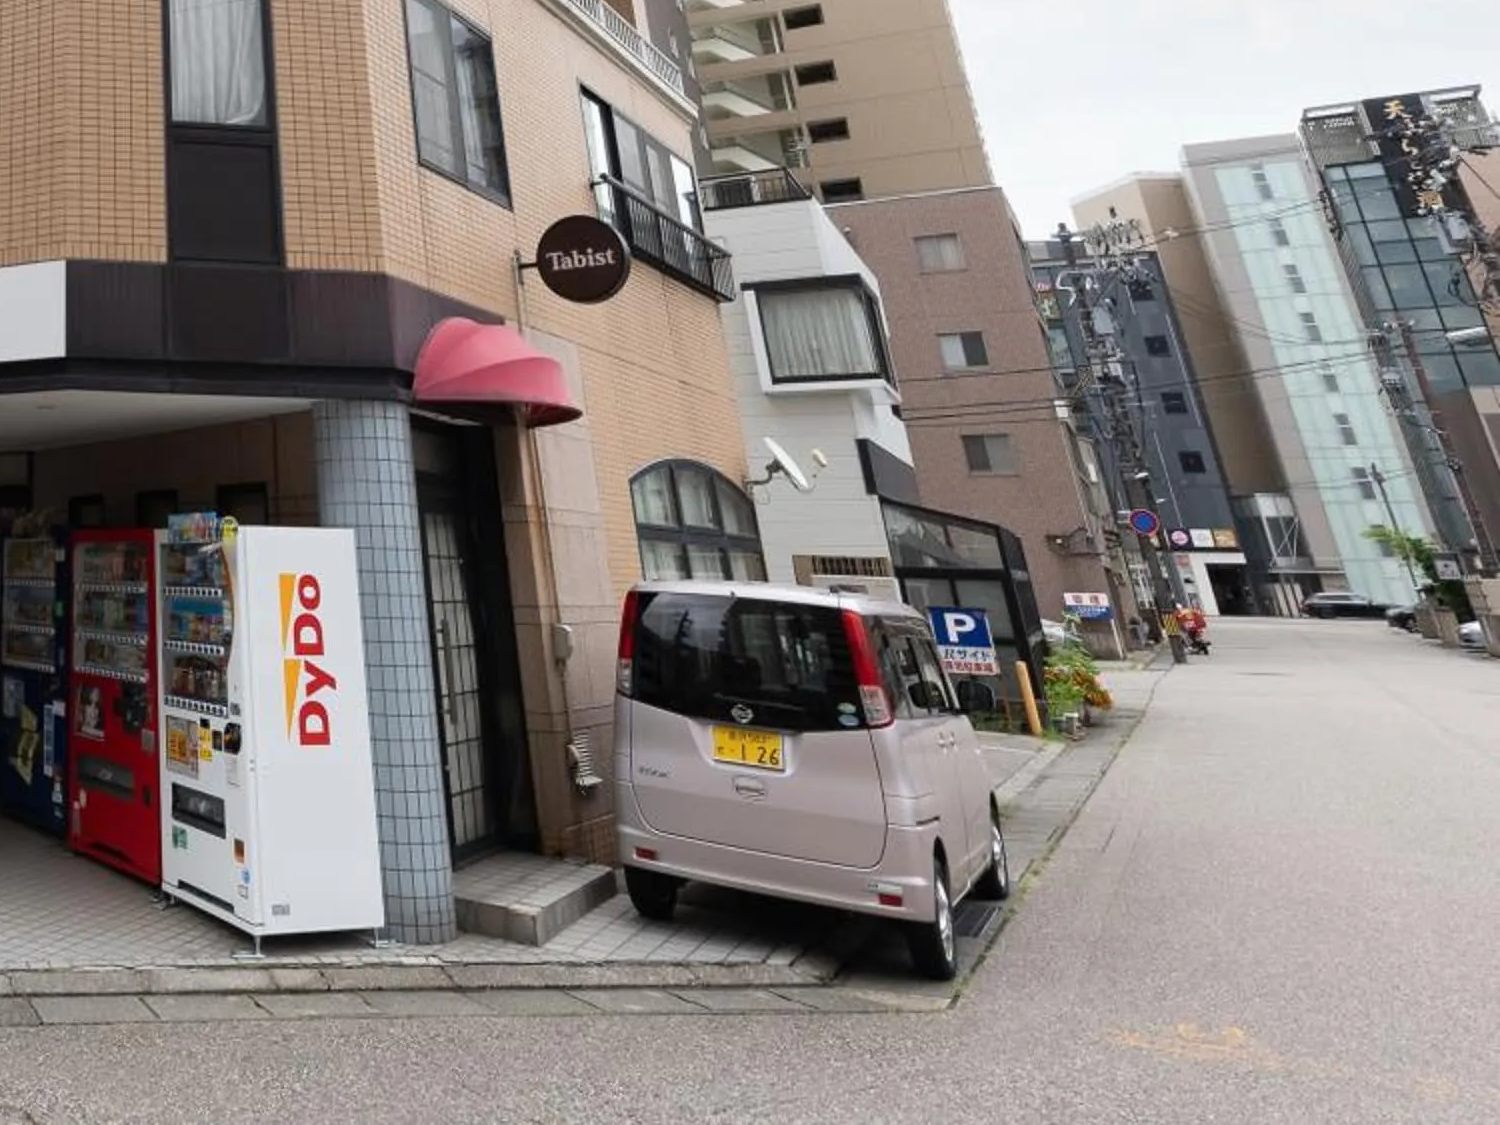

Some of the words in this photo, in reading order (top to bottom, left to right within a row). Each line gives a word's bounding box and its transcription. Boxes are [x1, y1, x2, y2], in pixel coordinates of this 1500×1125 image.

[545, 247, 617, 271] Tabist
[943, 612, 976, 643] P
[293, 573, 337, 746] DyDo
[945, 648, 991, 662] Rサイド
